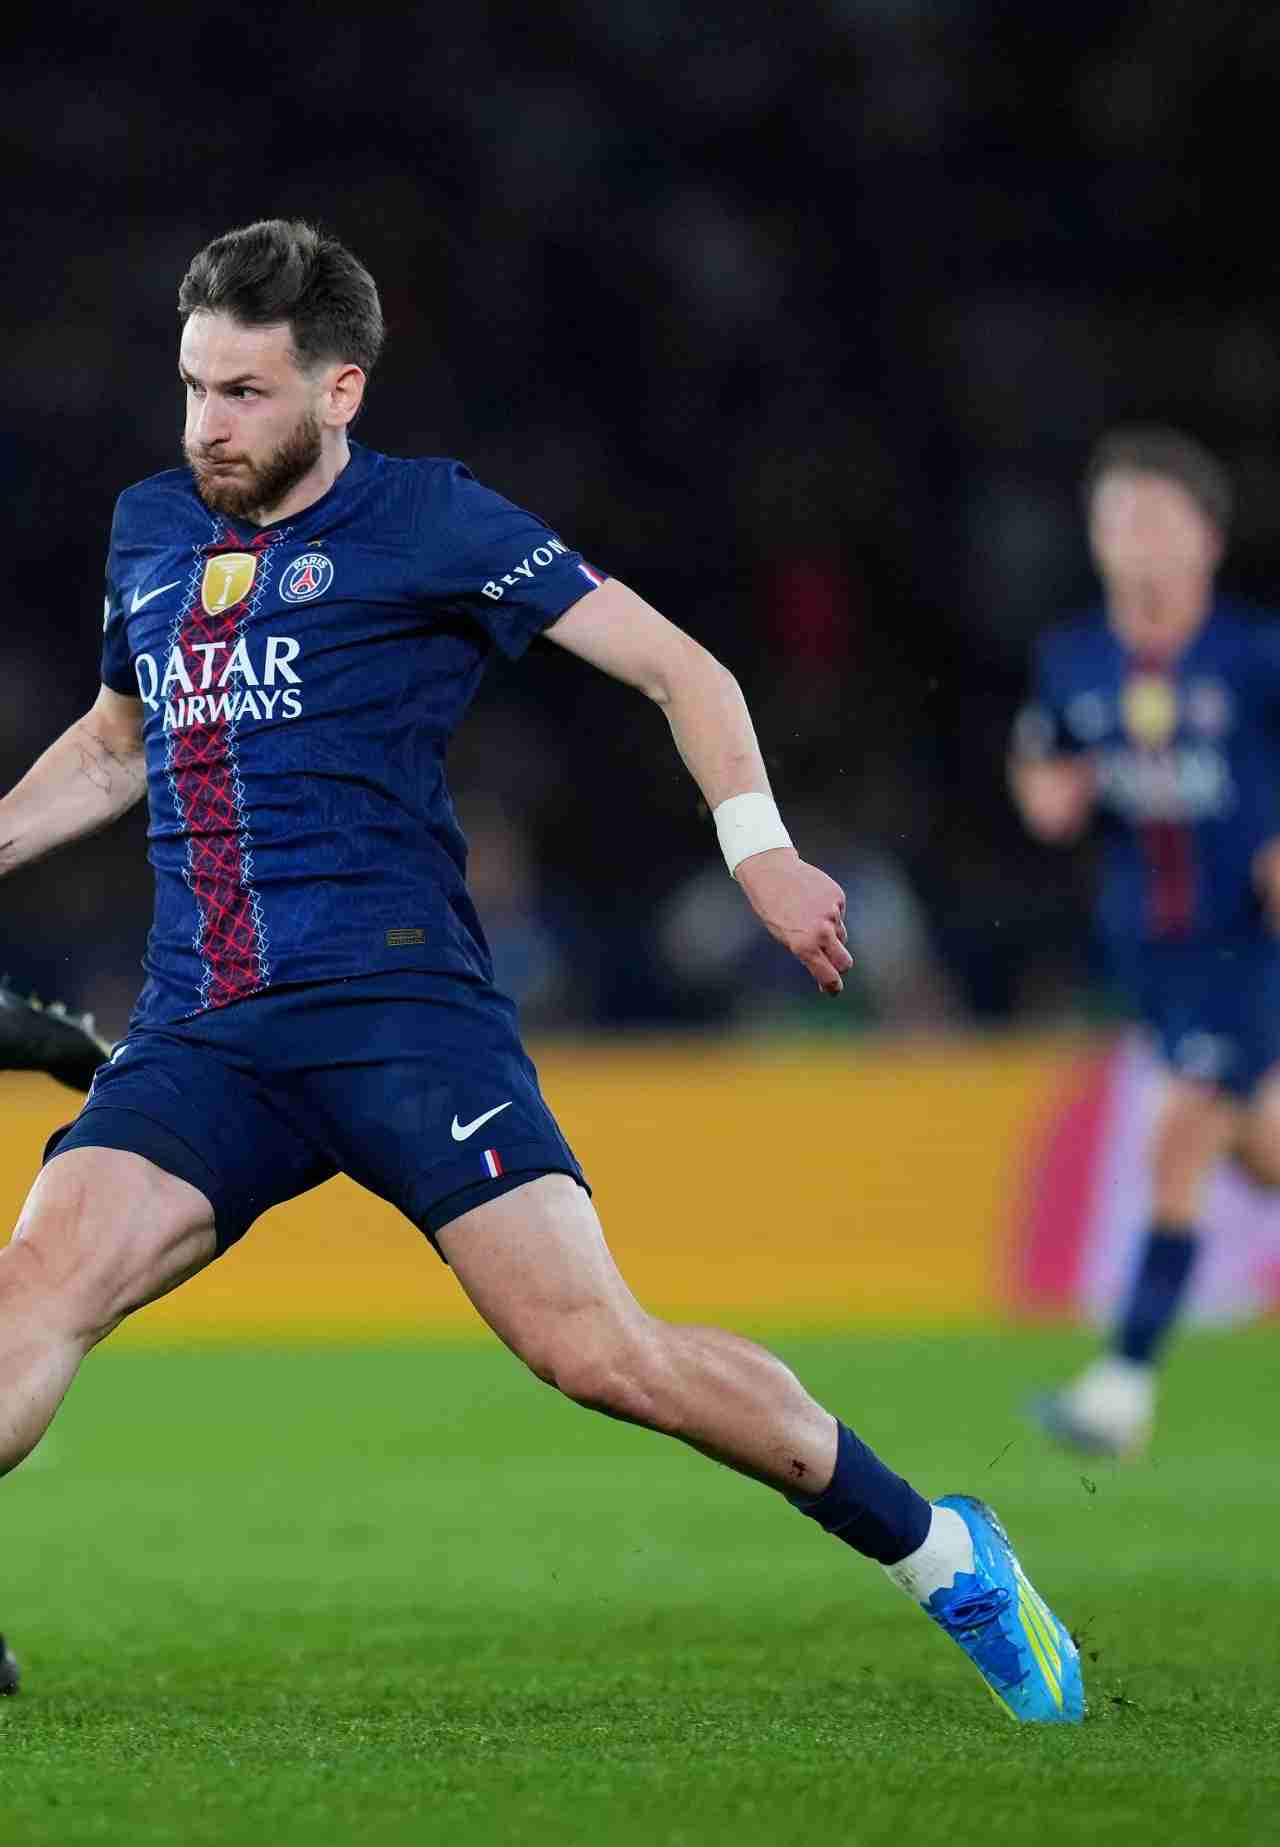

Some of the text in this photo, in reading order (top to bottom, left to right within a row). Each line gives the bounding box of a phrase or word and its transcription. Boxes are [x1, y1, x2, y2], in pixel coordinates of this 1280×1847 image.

[293, 557, 328, 569] PARIS
[135, 637, 304, 711] QATAR
[163, 689, 303, 731] AIRWAYS
